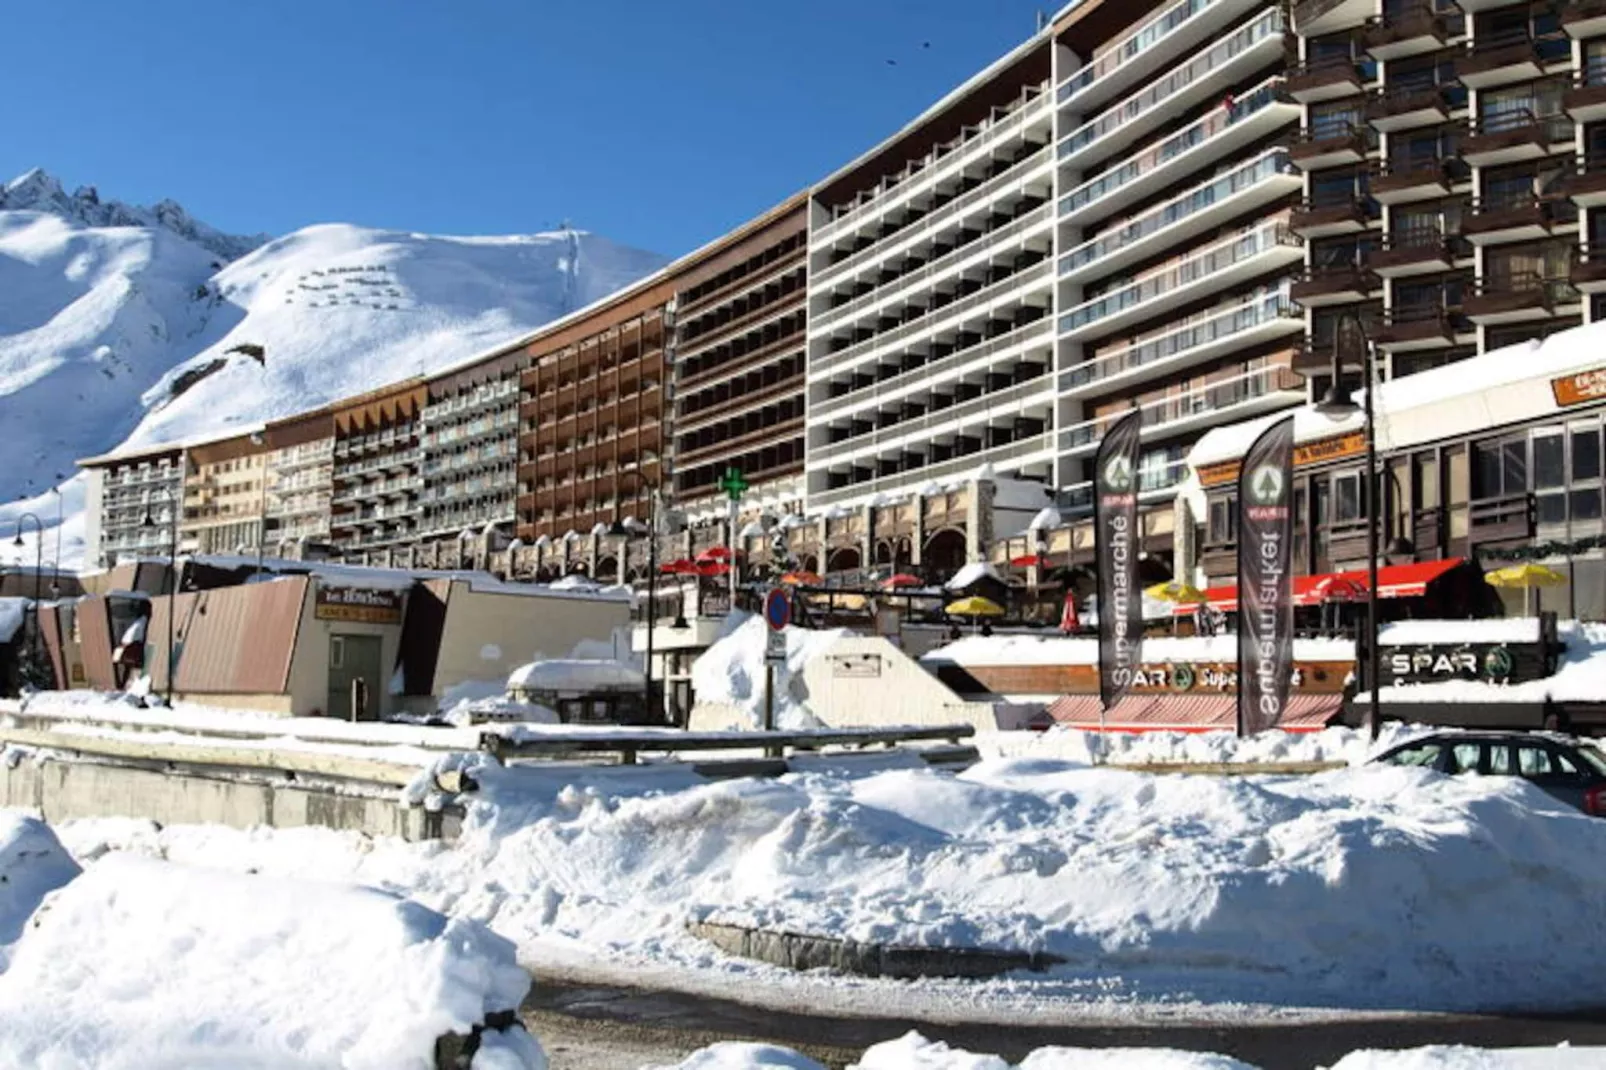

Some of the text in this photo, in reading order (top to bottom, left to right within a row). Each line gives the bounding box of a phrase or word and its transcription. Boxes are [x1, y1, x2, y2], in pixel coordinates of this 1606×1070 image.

[1108, 515, 1131, 686] Supermarché
[1391, 653, 1477, 674] SPAR
[1130, 671, 1166, 687] AR
